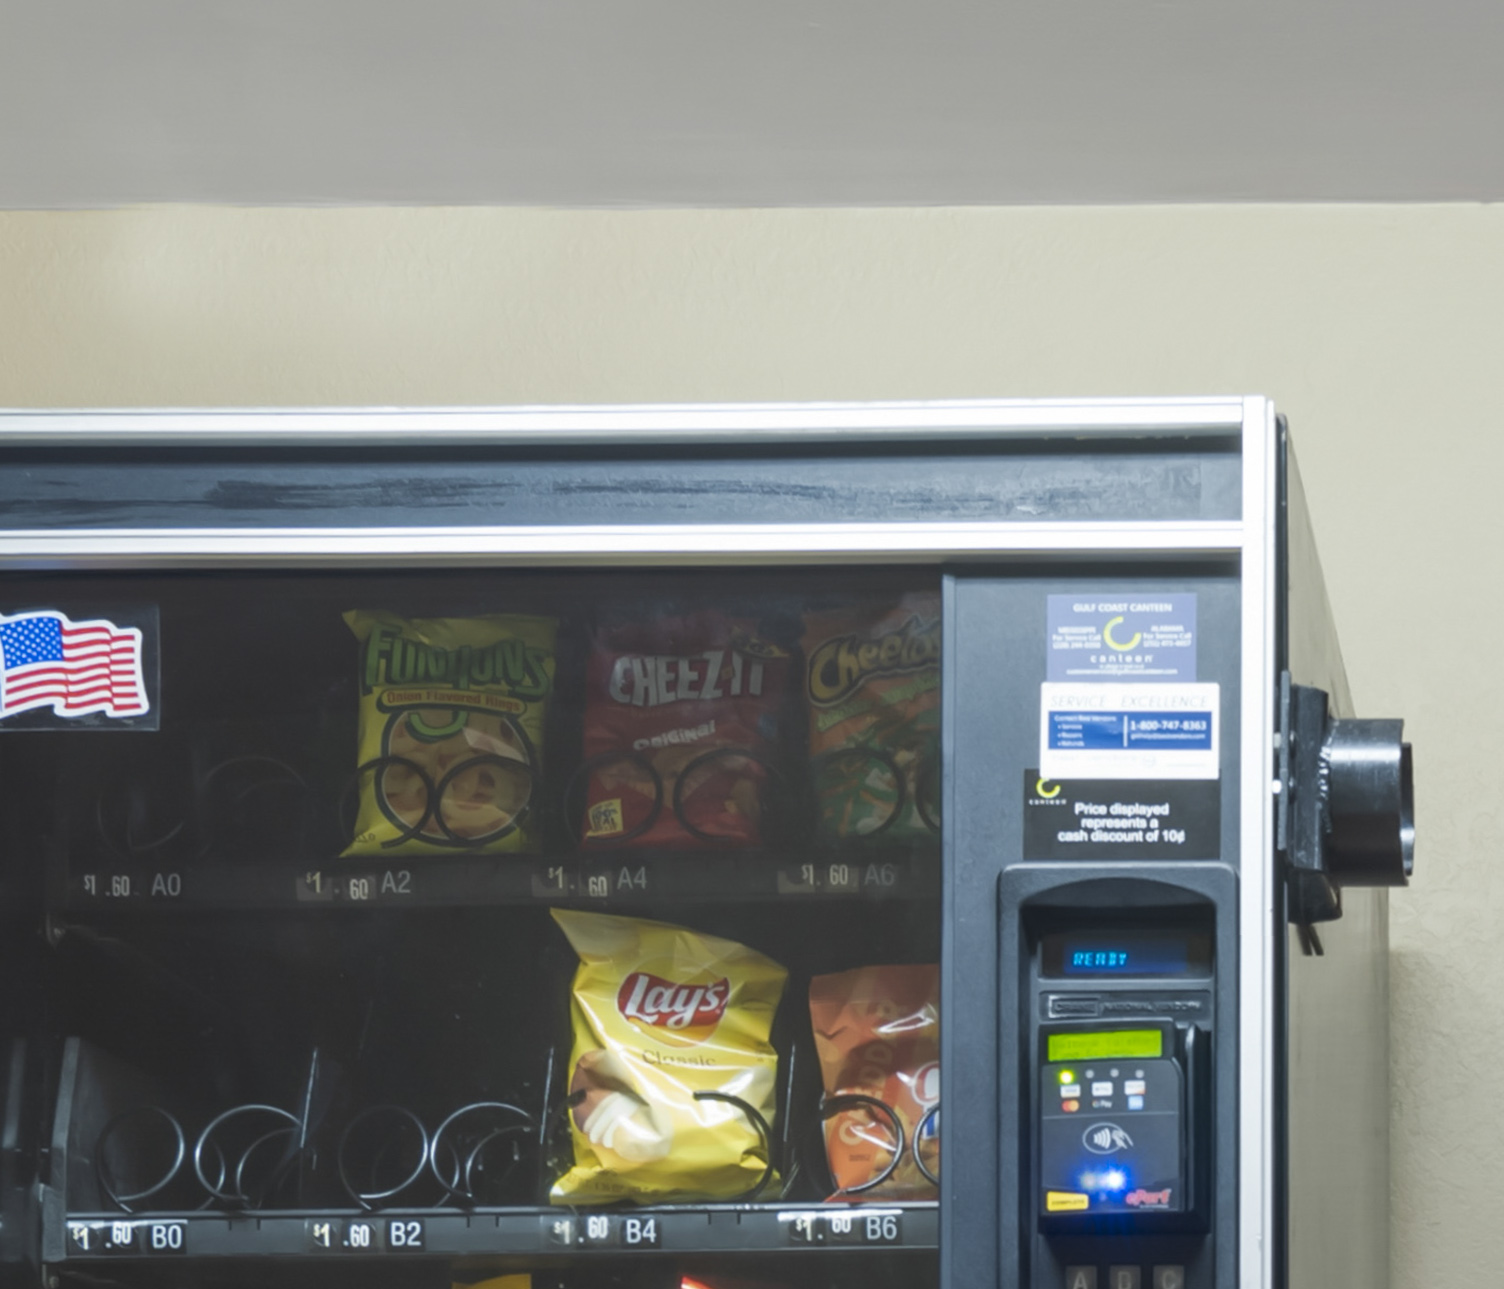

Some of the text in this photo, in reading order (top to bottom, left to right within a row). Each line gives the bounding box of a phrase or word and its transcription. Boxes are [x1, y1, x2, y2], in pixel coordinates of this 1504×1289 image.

[1098, 603, 1128, 612] COAST
[1130, 603, 1173, 612] CANTEEN
[1090, 653, 1153, 663] canteen
[1051, 696, 1207, 708] SERVICE EXCELLENCE
[1075, 803, 1169, 819] Price displayed
[1081, 817, 1158, 831] represents a
[1058, 830, 1088, 842] cash
[1091, 830, 1143, 843] discount
[1146, 830, 1159, 842] of
[152, 873, 181, 896] A0
[381, 871, 412, 894] A2
[617, 867, 648, 890] A4
[864, 863, 895, 886] A6
[1073, 952, 1128, 967] READY
[624, 972, 729, 1030] Lay's
[643, 1050, 717, 1068] Classic
[152, 1224, 182, 1249] B0
[390, 1221, 422, 1246] B2
[626, 1217, 656, 1243] B4
[866, 1215, 897, 1241] B6
